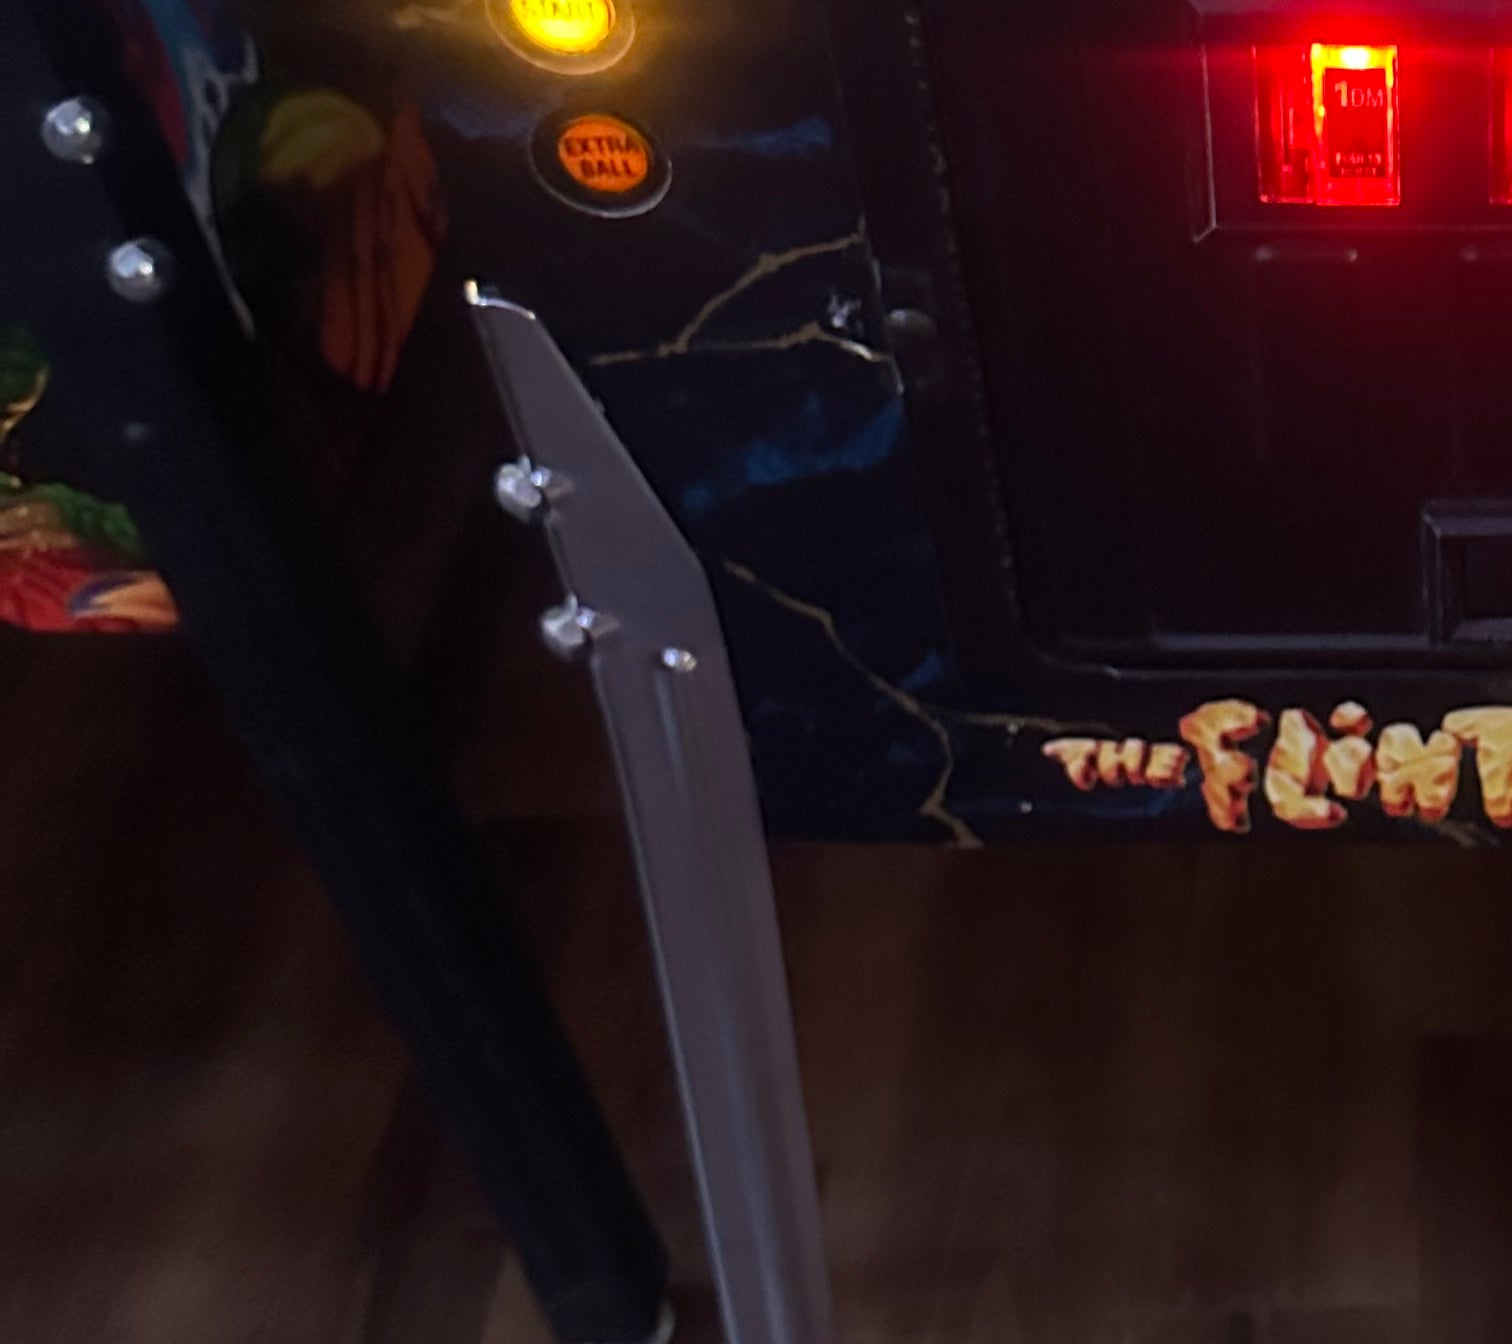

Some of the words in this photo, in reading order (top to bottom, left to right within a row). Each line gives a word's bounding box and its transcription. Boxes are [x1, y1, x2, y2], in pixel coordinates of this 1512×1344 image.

[563, 136, 638, 157] EXTRA
[580, 158, 635, 178] BALL
[1041, 737, 1190, 792] THE
